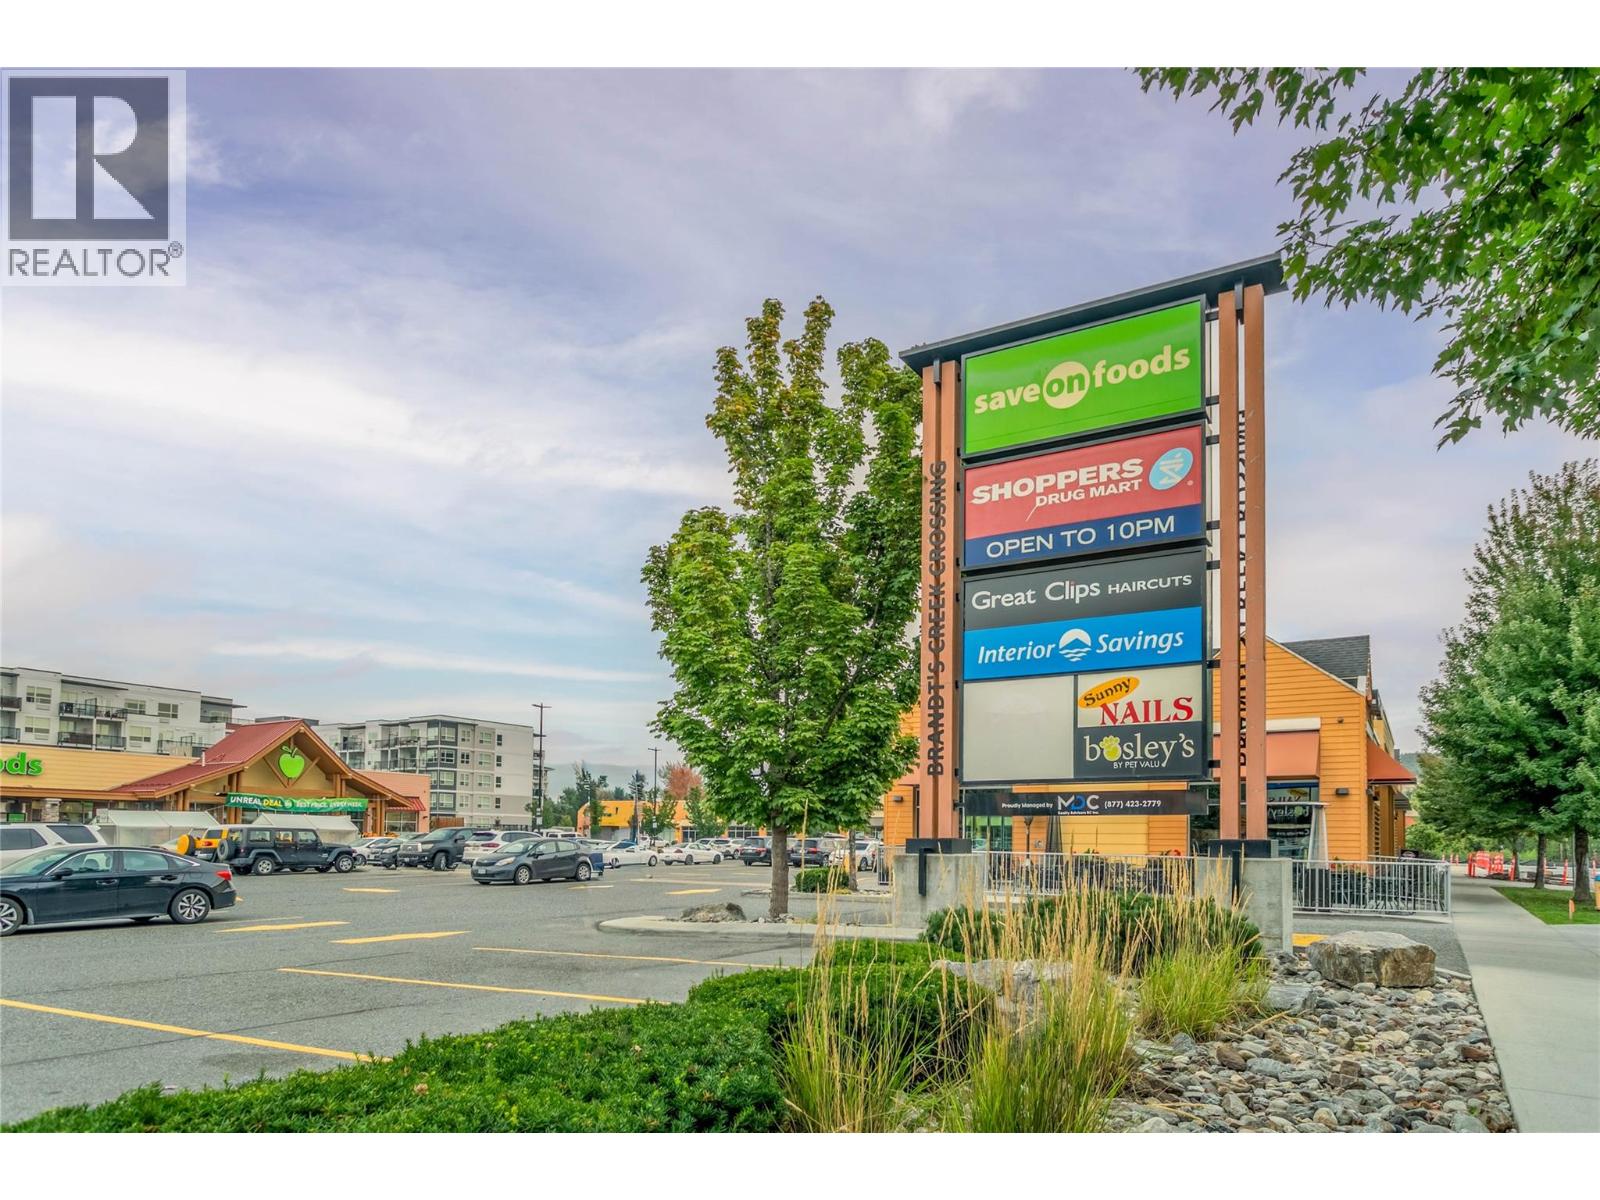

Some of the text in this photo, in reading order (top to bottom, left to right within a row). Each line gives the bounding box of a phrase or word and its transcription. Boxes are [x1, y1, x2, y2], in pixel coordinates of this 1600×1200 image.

[974, 345, 1191, 415] save on foods
[970, 458, 1144, 505] SHOPPERS
[1031, 478, 1143, 512] DRUG MART
[986, 515, 1176, 559] OPEN TO 10PM
[971, 574, 1193, 610] Great Clips HAIRCUTS
[927, 460, 947, 776] BRANDT'S CREEK CROSSING
[977, 629, 1185, 664] Interior Savings
[1083, 678, 1132, 707] Sunny
[1099, 696, 1194, 726] NAILS
[1113, 759, 1161, 770] BY PET VALU
[230, 796, 262, 805] UNREAL
[262, 799, 283, 807] DEAL
[1001, 802, 1053, 810] Proudly Managed by
[1104, 799, 1162, 809] (877) 423-2779
